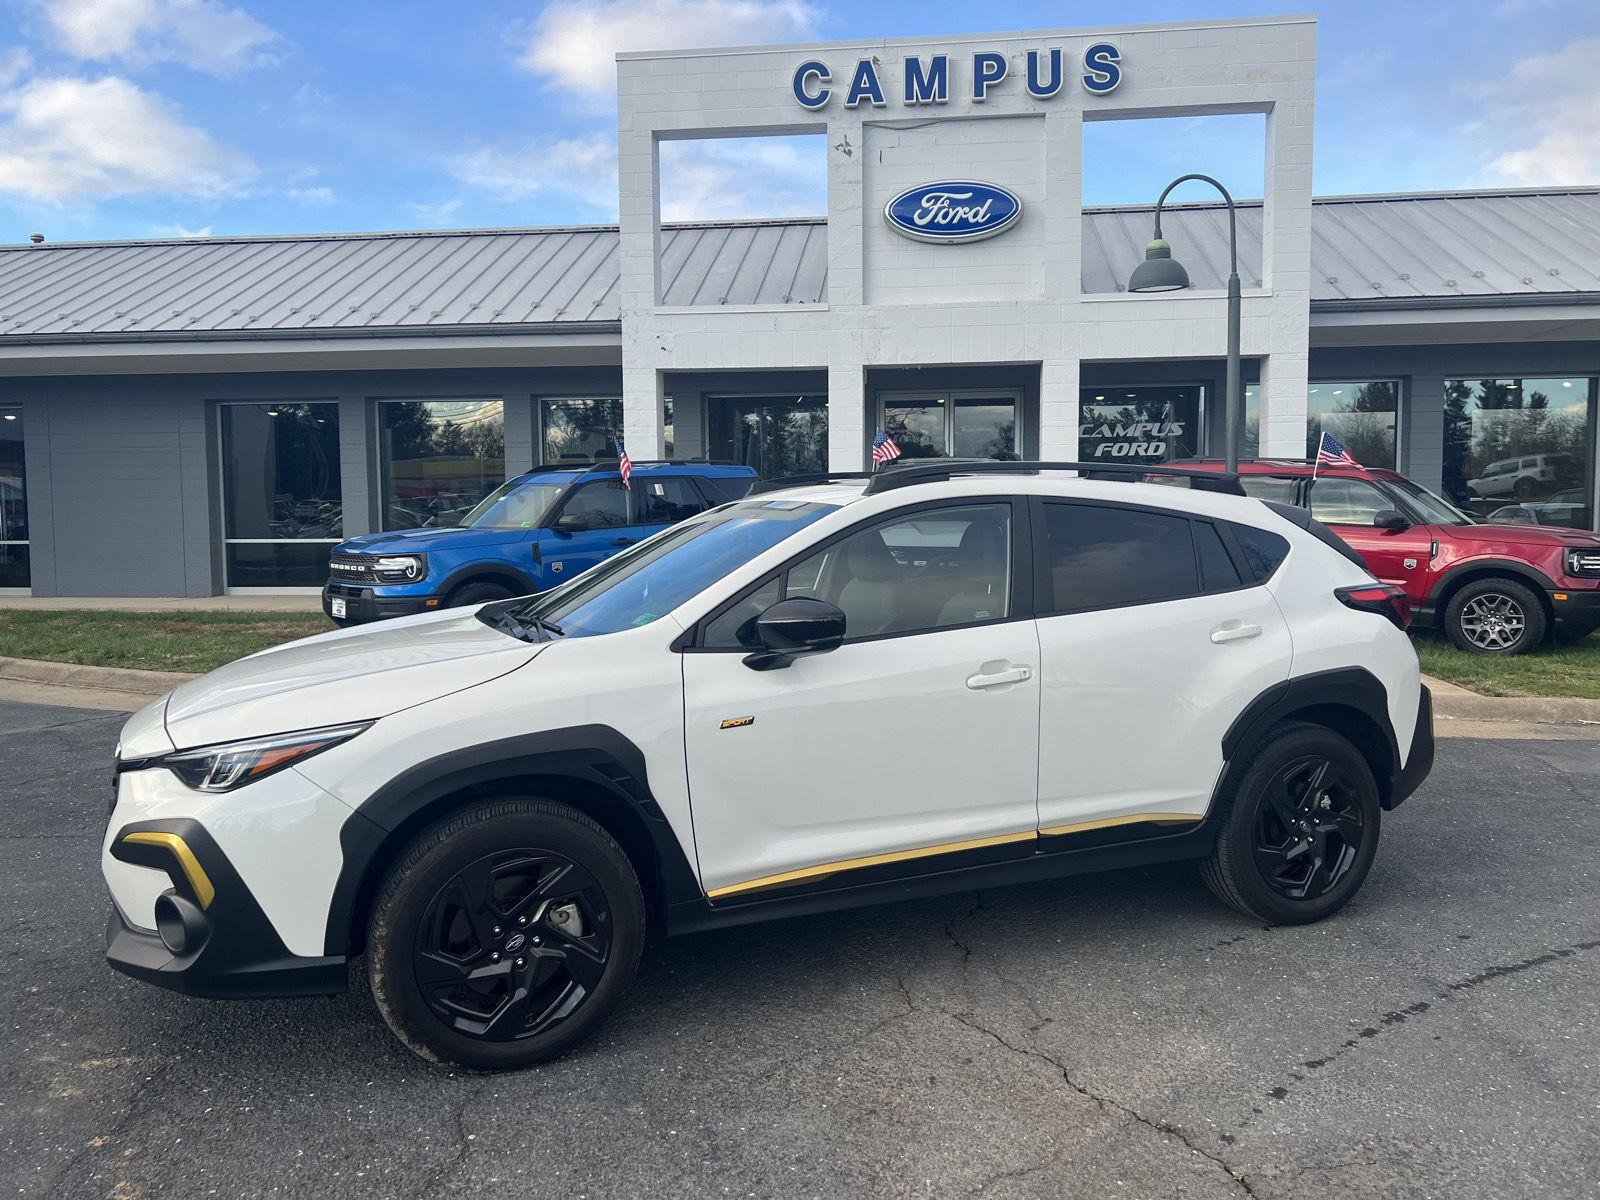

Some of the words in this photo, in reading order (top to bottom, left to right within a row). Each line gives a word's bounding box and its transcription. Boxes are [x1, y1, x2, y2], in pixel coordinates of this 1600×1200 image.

[792, 42, 1123, 111] CAMPUS
[913, 192, 992, 226] Ford
[1079, 421, 1185, 438] CAMPUS
[1094, 441, 1167, 457] FORD
